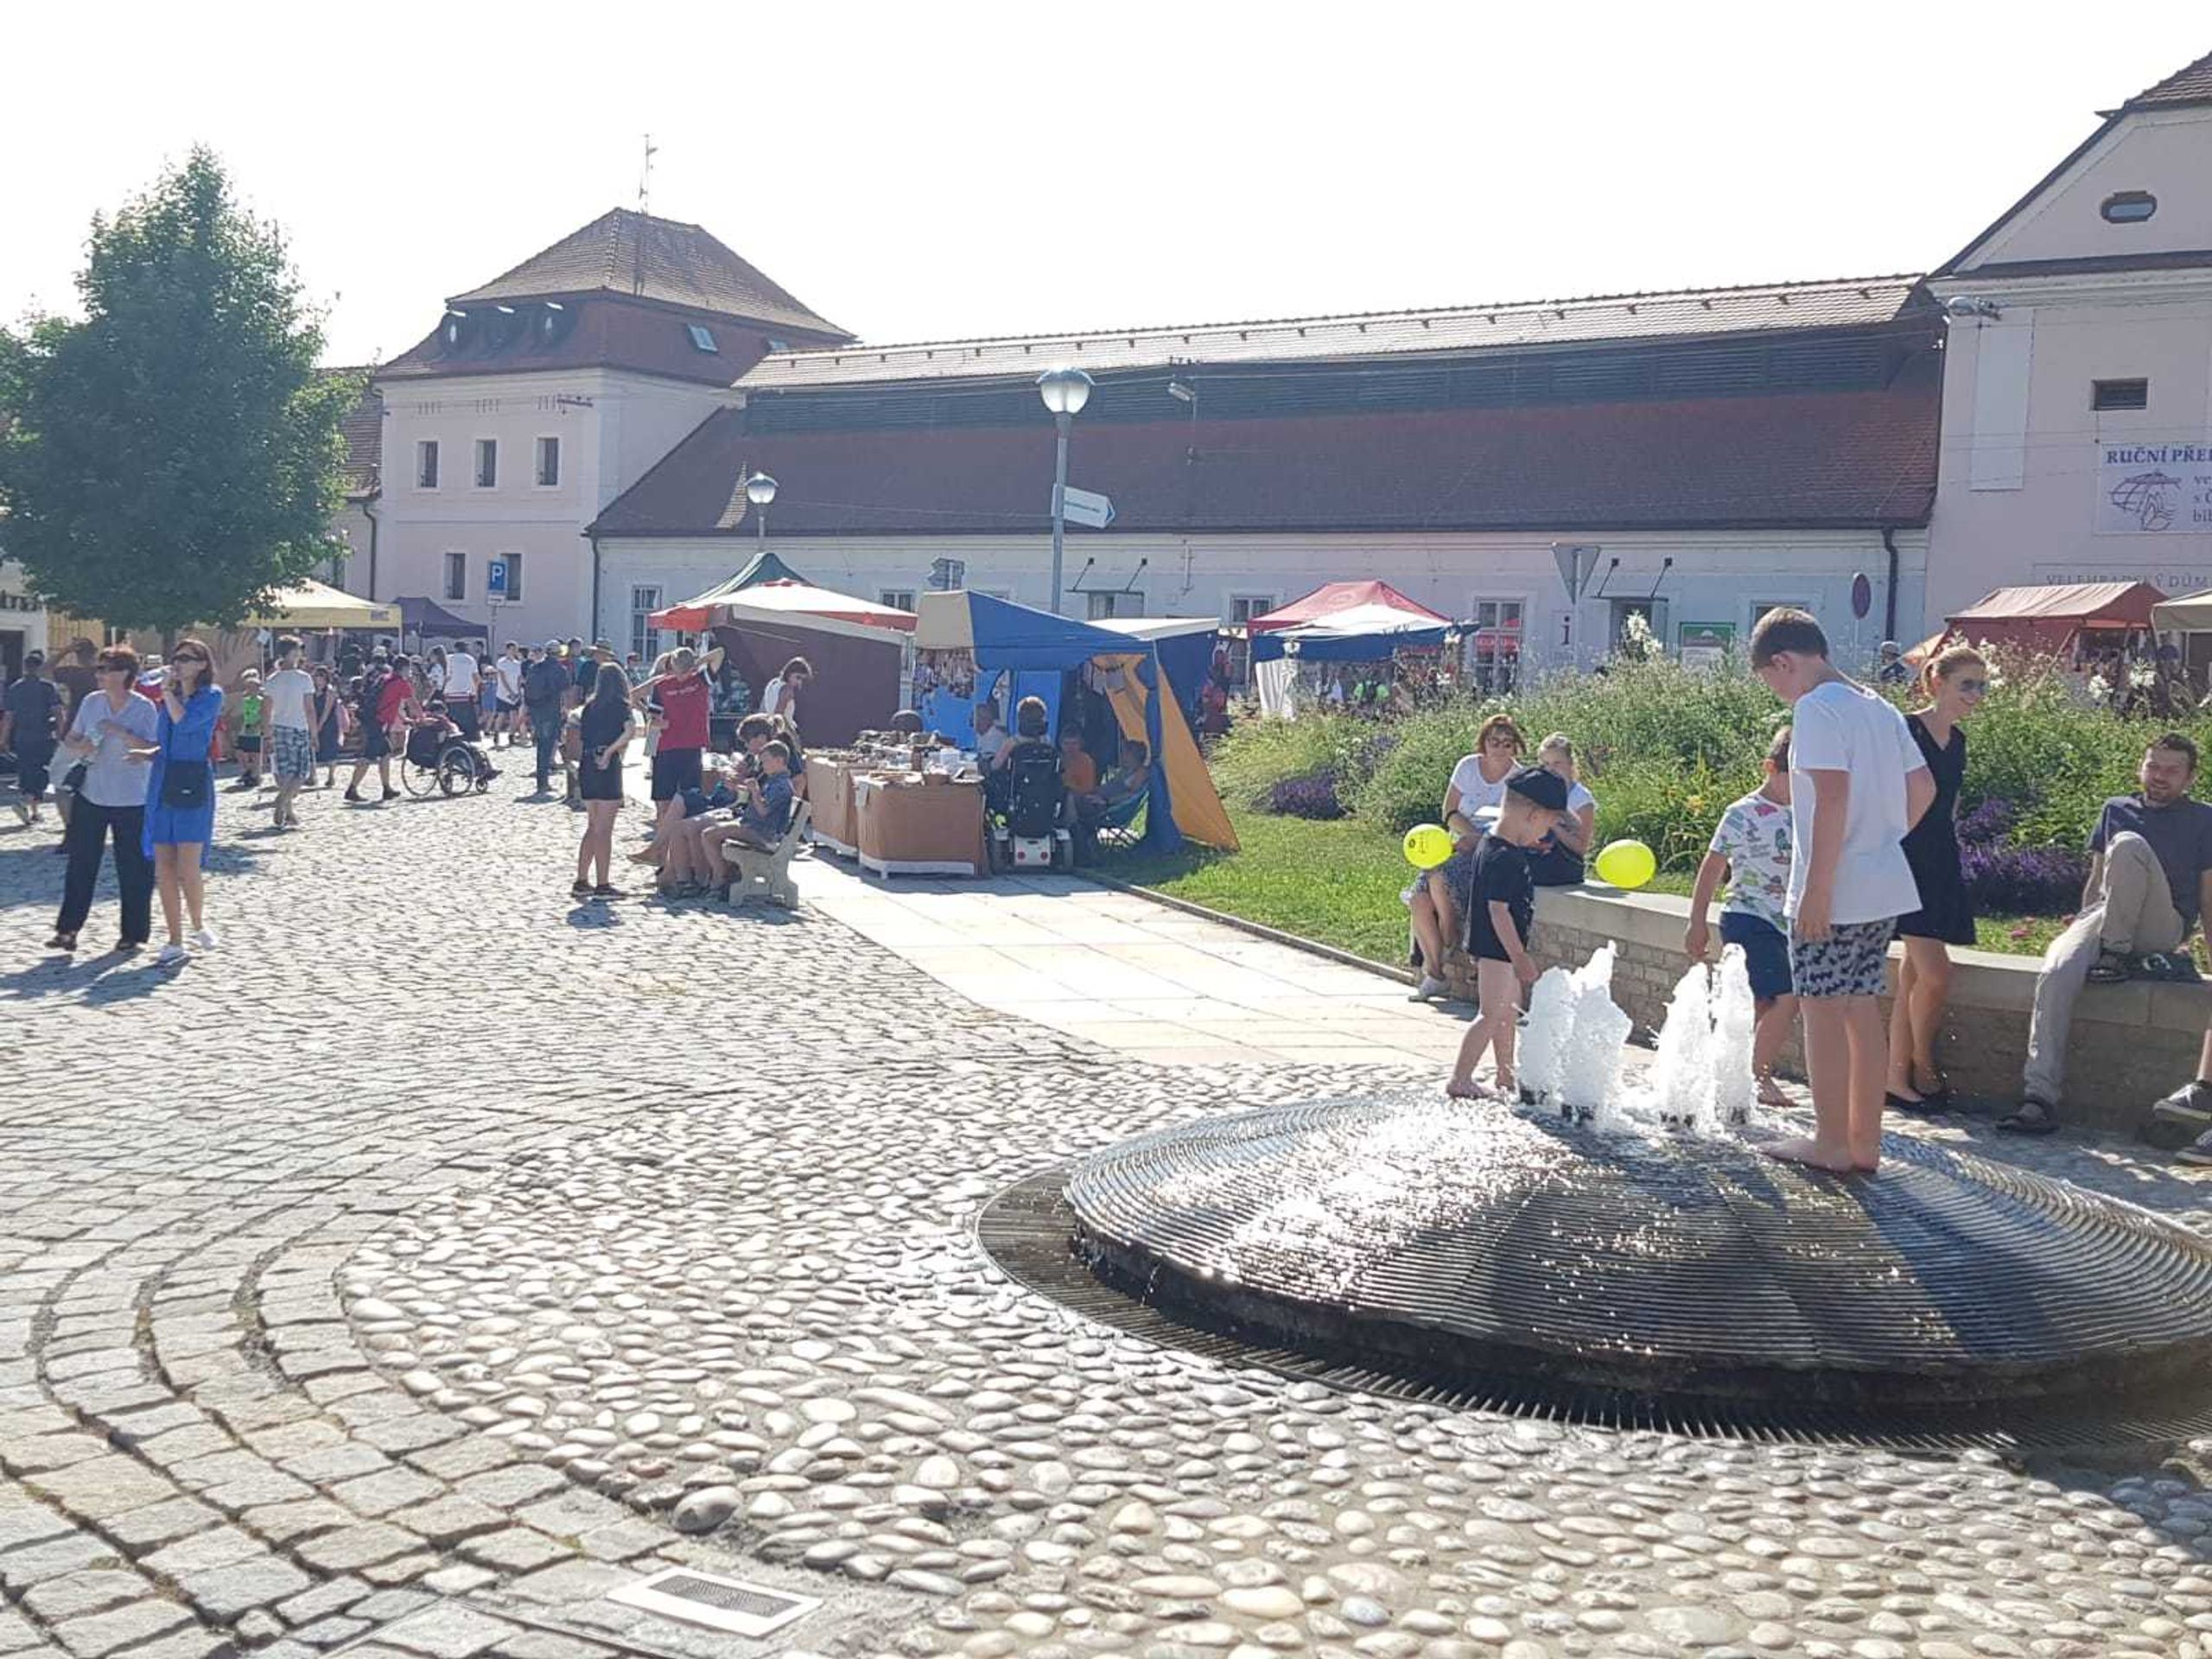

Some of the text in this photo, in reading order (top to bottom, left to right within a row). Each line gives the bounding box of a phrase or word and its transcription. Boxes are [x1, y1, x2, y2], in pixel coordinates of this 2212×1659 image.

[2107, 444, 2212, 463] RUČNÍ PŘE
[492, 564, 504, 583] P
